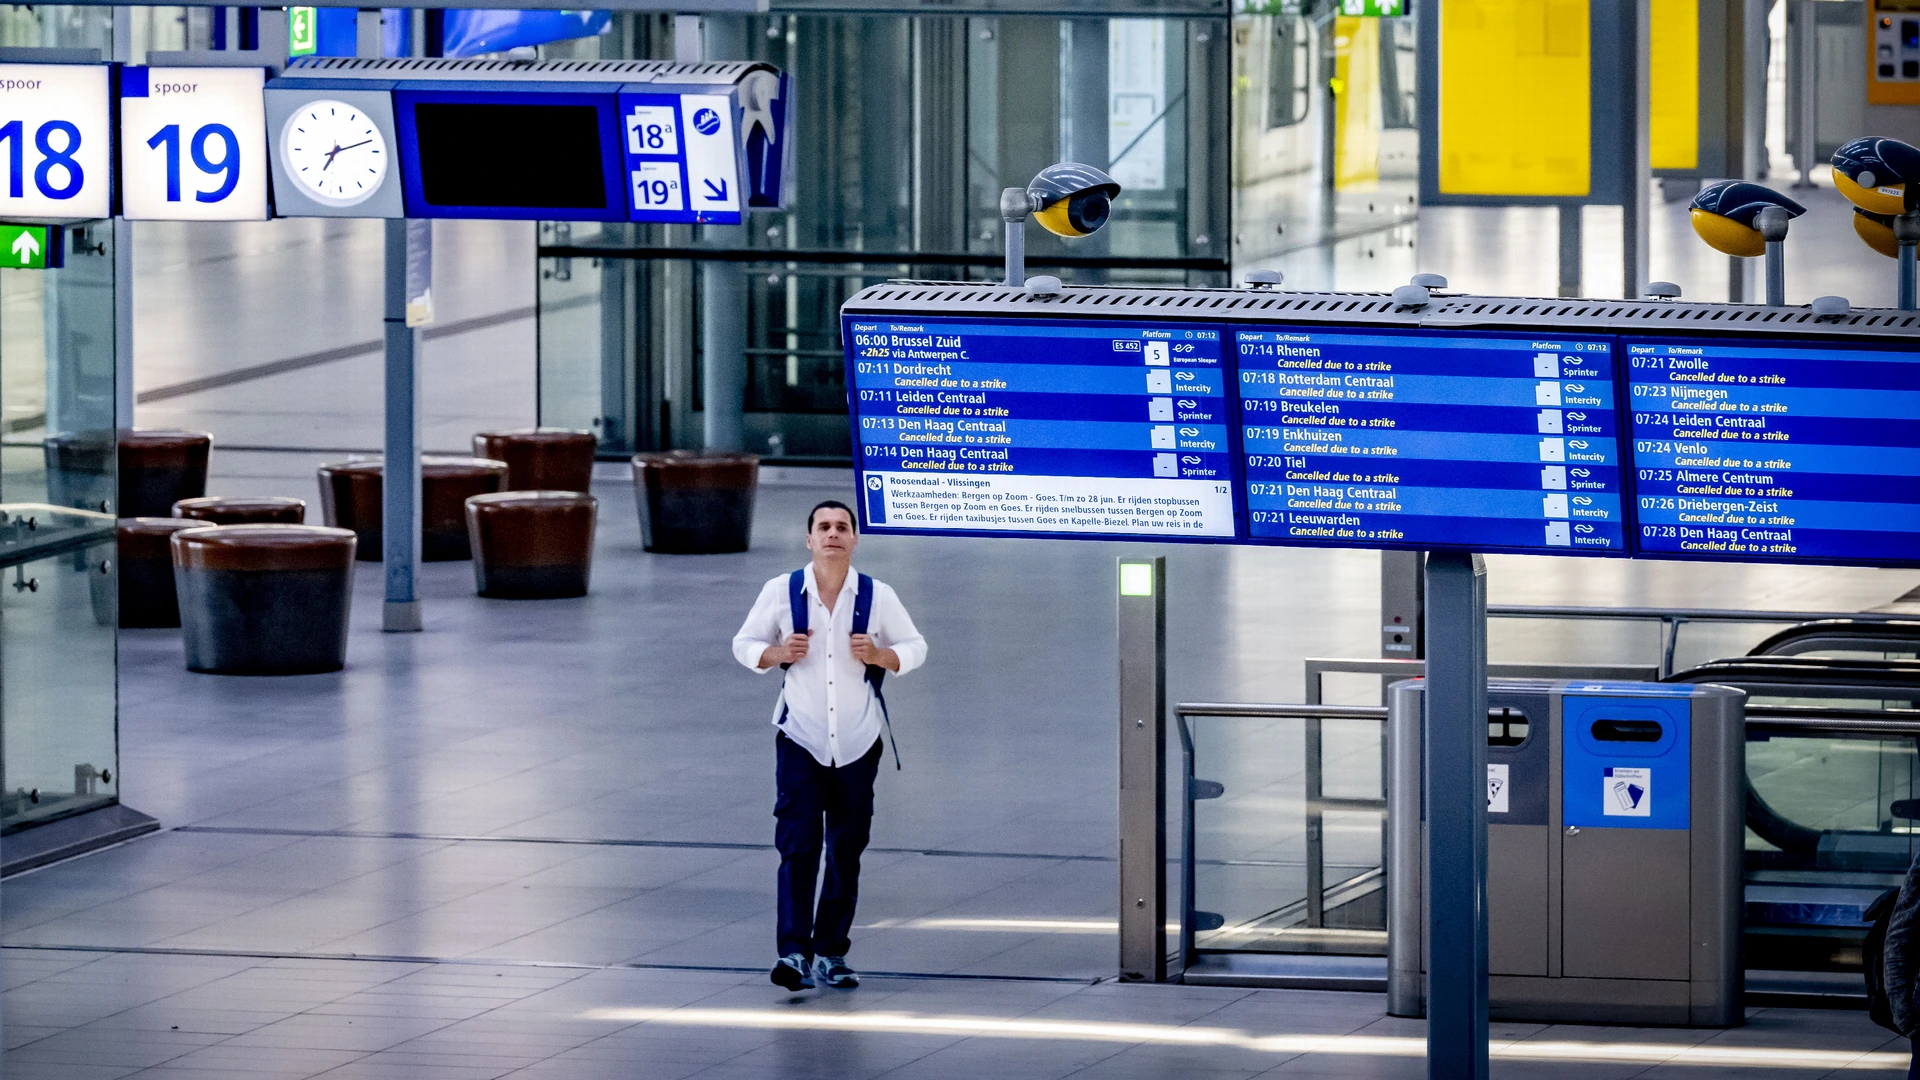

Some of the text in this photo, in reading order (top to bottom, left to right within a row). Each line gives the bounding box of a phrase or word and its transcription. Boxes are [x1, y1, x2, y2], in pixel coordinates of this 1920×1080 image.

[0, 79, 42, 92] spoor
[155, 82, 198, 96] spoor
[0, 120, 84, 200] 18
[146, 123, 241, 204] 19
[854, 323, 924, 332] Depart To/Remark
[1142, 330, 1171, 338] Platform
[855, 334, 961, 348] 06:00 Brussel Zuid
[1239, 333, 1310, 342] Depart To/Remark
[1115, 342, 1139, 350] ES 452
[1240, 343, 1320, 357] 07:14 Rhenen
[1531, 342, 1561, 350] Platform
[1587, 343, 1607, 352] 07:12
[1631, 346, 1703, 355] Depart To/Remark
[860, 347, 970, 361] +2h25 via Antwerpen C.
[1153, 349, 1161, 360] 5
[857, 362, 952, 376] 07:11 Dordrecht
[1632, 357, 1709, 370] 07:21 Zwolle
[1563, 367, 1598, 378] Sprinter
[894, 377, 1007, 389] Cancelled due to a strike
[1242, 371, 1394, 388] 07:18 Rotterdam Centraal
[1175, 383, 1211, 394] Intercity
[1279, 387, 1394, 400] Cancelled due to a strike
[1633, 385, 1728, 401] 07:23 Nijmegen
[860, 390, 986, 404] 07:11 Leiden Centraal
[1565, 396, 1601, 407] Intercity
[1244, 399, 1340, 414] 07:19 Breukelen
[1671, 400, 1788, 413] Cancelled due to a strike
[1178, 411, 1212, 421] Sprinter
[1635, 413, 1766, 428] 07:24 Leiden Centraal
[862, 417, 1006, 434] 07:13 Den Haag Centraal
[1567, 423, 1602, 434] Sprinter
[1246, 427, 1342, 442] 07:19 Enkhuizen
[1180, 439, 1216, 450] Intercity
[1637, 441, 1708, 455] 07:24 Venlo
[865, 445, 1008, 461] 07:14 Den Haag Centraal
[1569, 452, 1605, 463] Intercity
[1248, 455, 1306, 468] 07:20 Tiel
[1182, 467, 1217, 477] Sprinter
[1639, 469, 1773, 485] 07:25 Almere Centrum
[890, 476, 940, 486] Roosendaal
[946, 478, 991, 489] Vlissingen
[1571, 480, 1606, 490] Sprinter
[1214, 486, 1228, 494] 1/2
[1250, 483, 1397, 500] 07:21 Den Haag Centraal
[890, 489, 960, 499] Werkzaamheden:
[961, 491, 990, 502] Bergen
[992, 494, 1003, 502] op
[1005, 492, 1028, 501] Zoom
[1035, 493, 1058, 502] Goes.
[1088, 495, 1099, 503] 28
[1100, 497, 1116, 505] jun.
[1117, 495, 1126, 504] Er
[1128, 496, 1152, 506] rijden
[1153, 497, 1200, 507] stopbussen
[892, 501, 918, 509] tussen
[920, 501, 949, 512] Bergen
[950, 503, 962, 512] op
[963, 502, 987, 511] Zoom
[1000, 503, 1023, 512] Goes.
[1025, 504, 1033, 512] Er
[1035, 504, 1059, 515] rijden
[1061, 505, 1106, 514] snelbussen
[1107, 507, 1134, 515] tussen
[1135, 507, 1165, 518] Bergen
[1166, 509, 1178, 518] op
[1179, 508, 1203, 517] Zoom
[1641, 497, 1778, 515] 07:26 Driebergen-Zeist
[1253, 511, 1360, 526] 07:21 Leeuwarden
[1572, 508, 1609, 519] Intercity
[905, 512, 928, 521] Goes.
[929, 513, 937, 521] Er
[940, 513, 964, 523] rijden
[965, 514, 1006, 525] taxibusjes
[1008, 515, 1034, 524] tussen
[1036, 516, 1057, 524] Goes
[1131, 518, 1150, 527] Plan
[1166, 519, 1181, 528] reis
[1193, 520, 1204, 529] de
[1643, 525, 1791, 542] 07:28 Den Haag Centraal
[1574, 536, 1611, 547] Intercity
